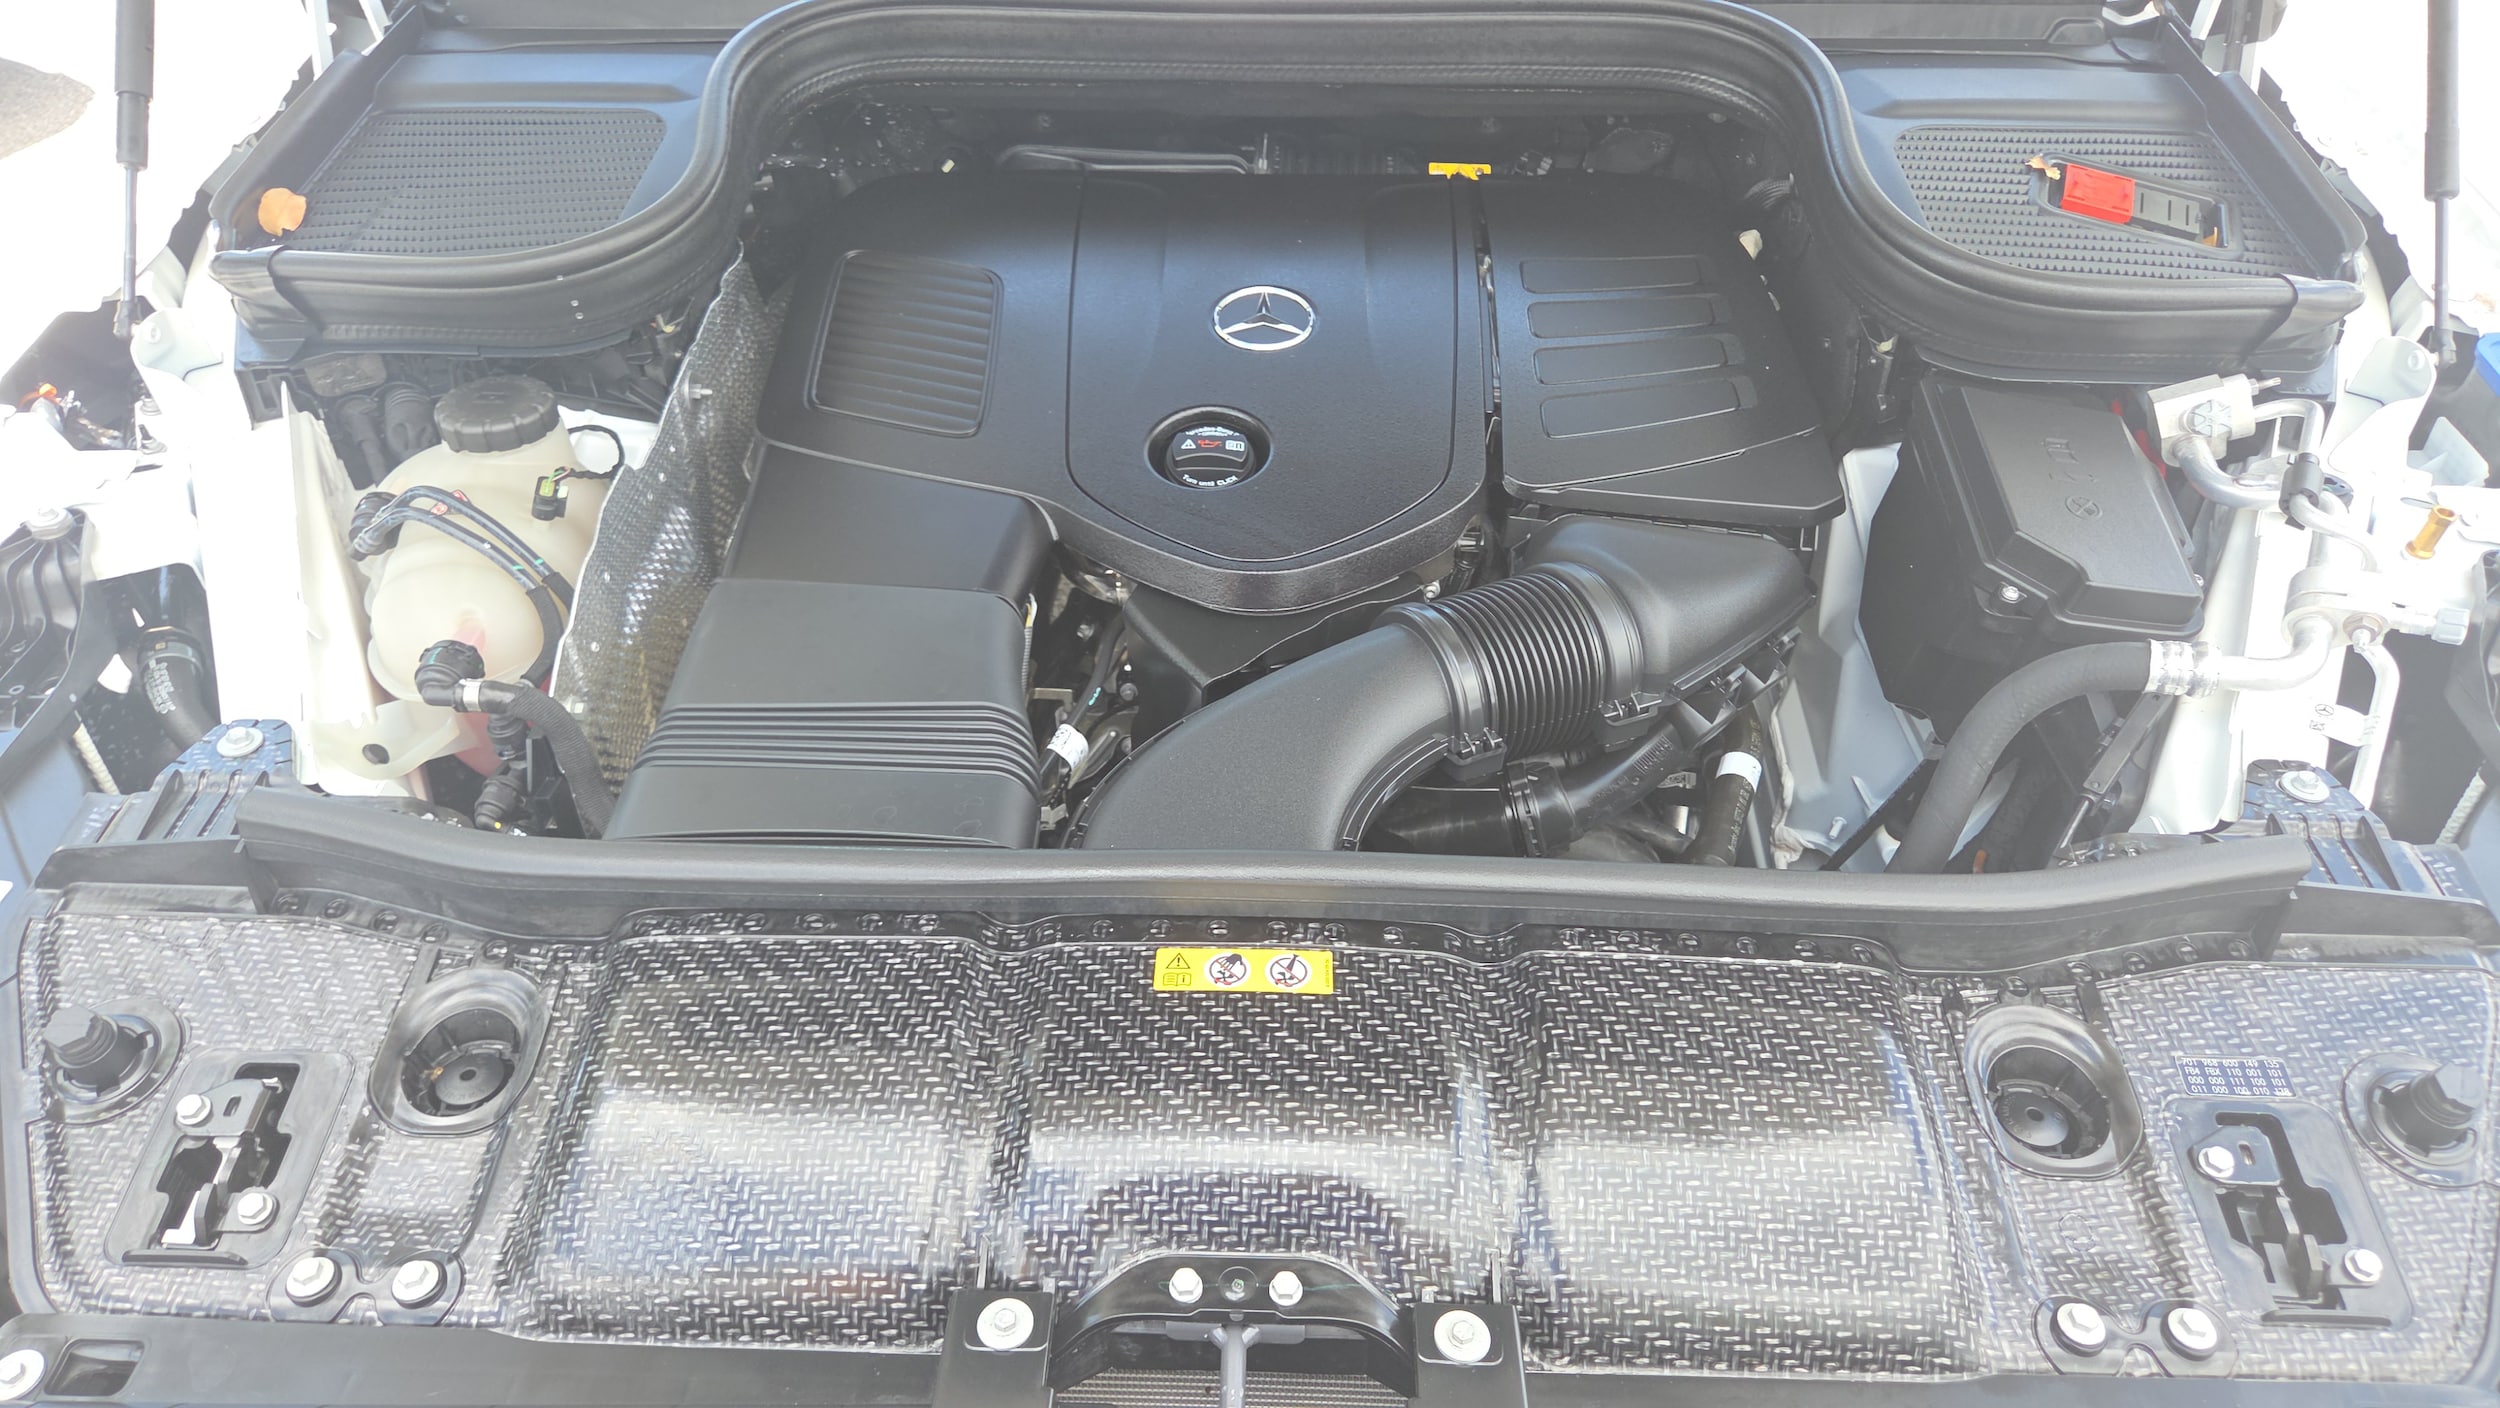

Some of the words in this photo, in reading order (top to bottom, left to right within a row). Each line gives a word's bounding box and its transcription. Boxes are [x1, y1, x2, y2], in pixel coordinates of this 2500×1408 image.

[1183, 474, 1198, 485] Turn
[1217, 475, 1239, 486] CLICK
[2230, 1077, 2245, 1085] 111
